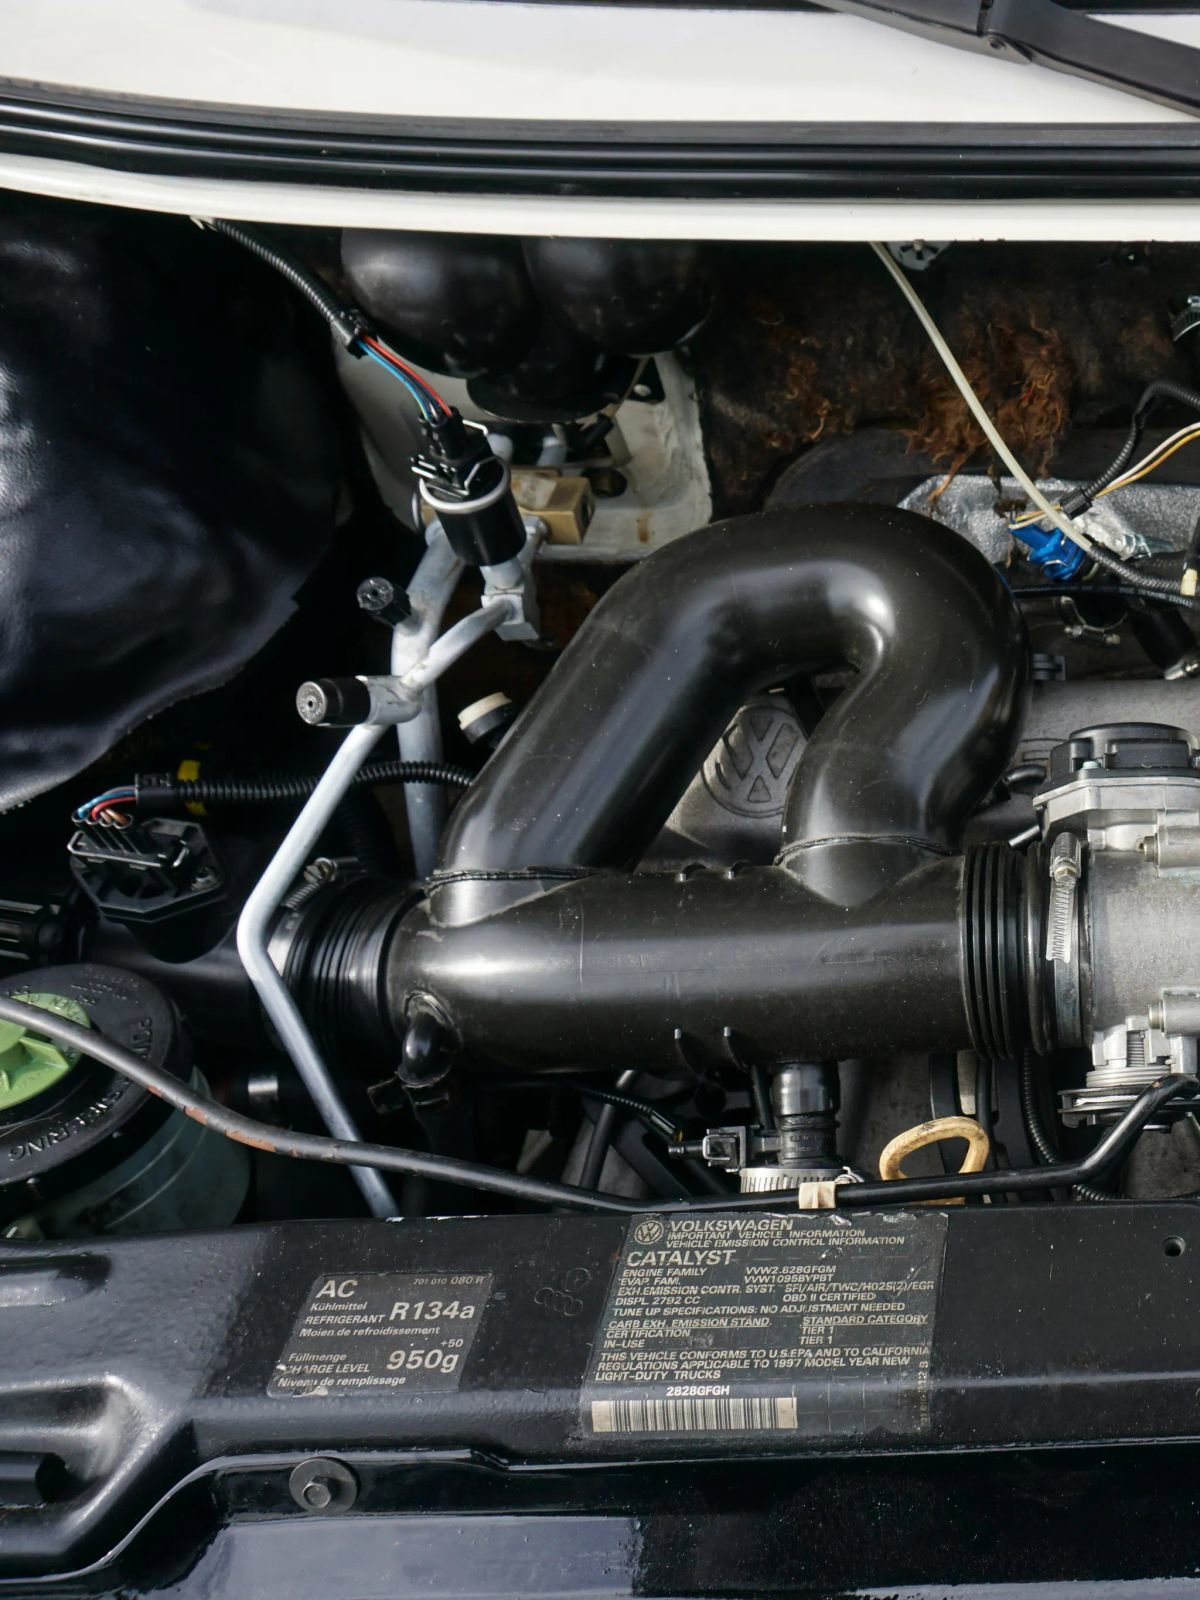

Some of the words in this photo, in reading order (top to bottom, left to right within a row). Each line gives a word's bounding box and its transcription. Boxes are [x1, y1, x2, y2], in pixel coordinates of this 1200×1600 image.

[670, 1219, 793, 1232] VOLKSWAGEN
[668, 1231, 730, 1239] IMPORTANT
[738, 1231, 783, 1239] VEHICLE
[789, 1229, 865, 1238] INFORMATION
[666, 1240, 710, 1248] VEHICLE
[714, 1239, 768, 1247] EMISSION
[772, 1238, 825, 1246] CONTROL
[828, 1236, 904, 1245] INFORMATION
[627, 1250, 736, 1266] CATALYST
[623, 1268, 663, 1277] ENGINE
[666, 1267, 707, 1276] FAMILY
[316, 1280, 357, 1298] AC
[451, 1276, 472, 1285] 080
[620, 1277, 650, 1286] EVAP.
[700, 1285, 742, 1294] CONTR.
[745, 1284, 776, 1294] SYST.
[652, 1296, 681, 1305] 2792
[684, 1296, 701, 1305] CC
[782, 1293, 806, 1303] OBD
[810, 1293, 817, 1302] II
[819, 1292, 876, 1302] CERTIFIED
[310, 1301, 367, 1312] Kühlmittel
[389, 1301, 475, 1320] R134a
[613, 1308, 643, 1317] TUNE
[645, 1308, 660, 1316] UP
[662, 1305, 758, 1316] SPECIFICATIONS:
[760, 1305, 778, 1314] NO
[780, 1303, 859, 1314] ADJUSTMENT
[861, 1302, 905, 1311] NEEDED
[305, 1314, 385, 1324] REFRIGERANT
[608, 1320, 640, 1328] CARB
[642, 1320, 669, 1328] EXH.
[671, 1318, 728, 1327] EMISSION
[730, 1317, 773, 1326] STAND.
[803, 1315, 865, 1325] STANDARD
[867, 1314, 928, 1324] CATEGORY
[337, 1327, 350, 1336] de
[353, 1326, 440, 1337] refroidissement
[606, 1329, 691, 1339] CERTIFICATION
[801, 1327, 825, 1335] TIER
[829, 1326, 834, 1334] 1
[440, 1338, 463, 1348] +50
[603, 1340, 645, 1349] IN-USE
[800, 1337, 823, 1345] TIER
[828, 1336, 833, 1344] 1
[601, 1352, 627, 1361] THIS
[630, 1351, 677, 1361] VEHICLE
[679, 1350, 747, 1360] CONFORMS
[751, 1350, 766, 1359] TO
[815, 1348, 841, 1358] AND
[844, 1348, 859, 1357] TO
[862, 1346, 930, 1357] CALIFORNIA
[288, 1352, 347, 1362] Füllmenge
[386, 1349, 459, 1374] 950g
[598, 1361, 678, 1371] REGULATIONS
[680, 1359, 750, 1370] APPLICABLE
[754, 1360, 769, 1369] TO
[773, 1359, 801, 1368] 1997
[804, 1358, 846, 1367] MODEL
[849, 1357, 879, 1367] YEAR
[882, 1356, 910, 1366] NEW
[287, 1365, 333, 1374] CHARGE
[335, 1364, 370, 1373] LEVEL
[595, 1371, 669, 1381] LIGHT-DUTY
[674, 1370, 721, 1380] TRUCKS
[320, 1377, 334, 1386] de
[336, 1376, 406, 1388] remplissage
[666, 1385, 731, 1396] 2828GFGH
